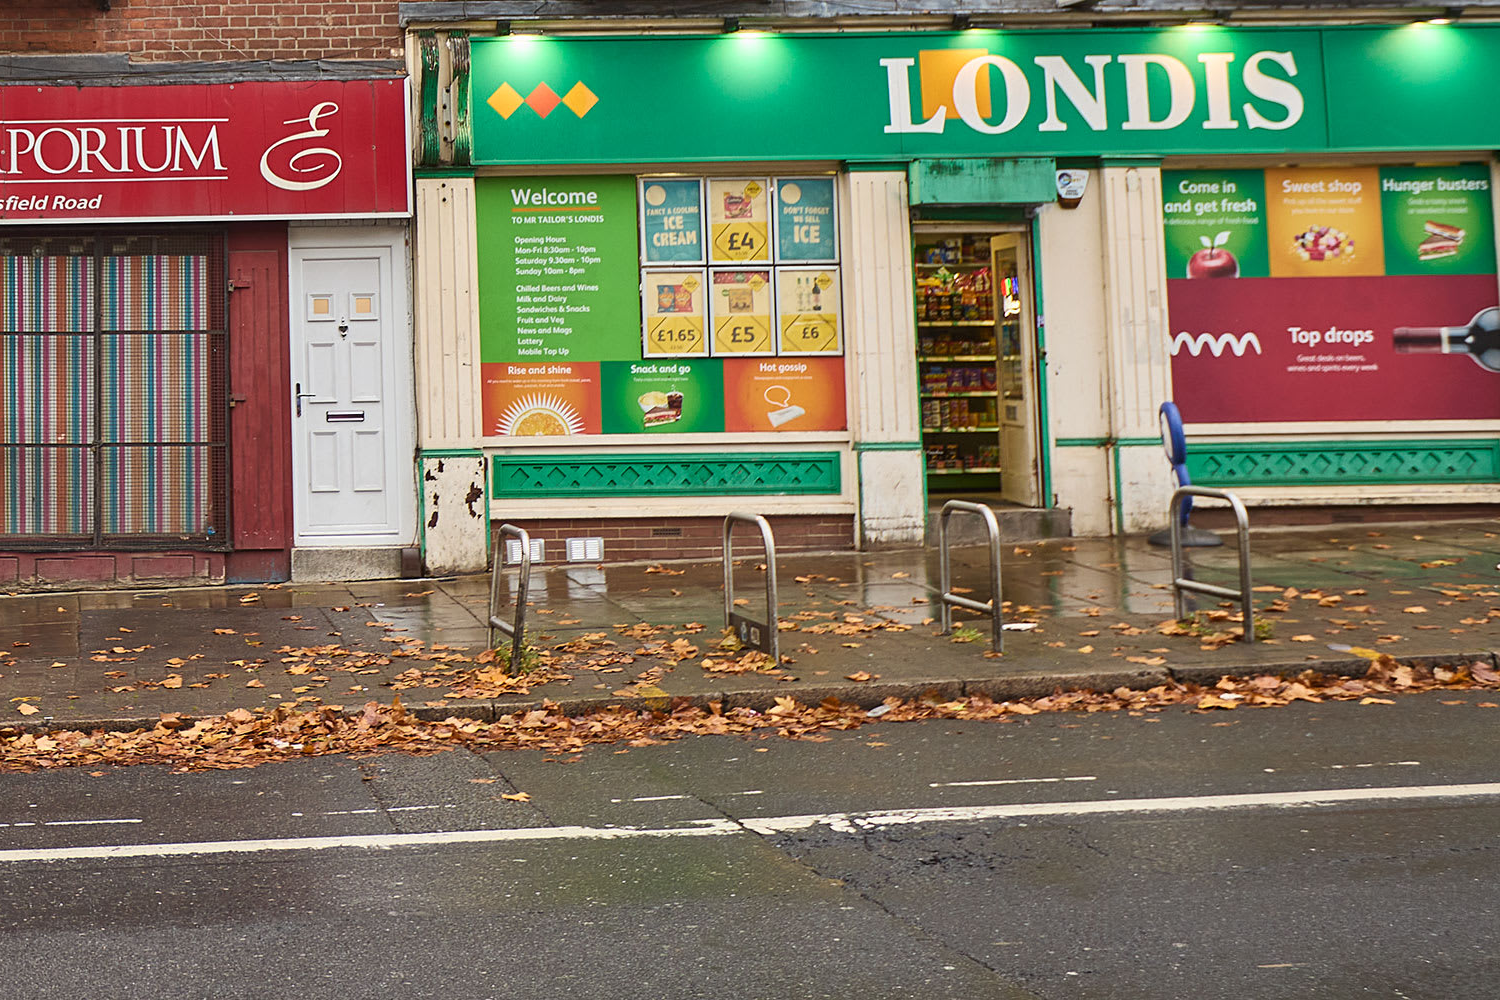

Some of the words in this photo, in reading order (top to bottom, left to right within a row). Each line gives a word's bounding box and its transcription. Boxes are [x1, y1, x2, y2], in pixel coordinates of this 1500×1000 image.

[880, 51, 1304, 135] LONDIS
[1179, 180, 1220, 194] Come
[1222, 180, 1236, 193] in
[1282, 179, 1325, 193] Sweet
[1328, 179, 1362, 196] shop
[1382, 178, 1434, 195] Hunger
[1436, 177, 1488, 191] busters
[52, 194, 102, 210] Road
[511, 188, 598, 205] Welcome
[647, 208, 666, 216] FANCY
[667, 207, 672, 215] A
[673, 206, 699, 215] COOLING
[783, 206, 803, 215] DON'T
[805, 206, 830, 215] FORGET
[1164, 199, 1191, 213] and
[1194, 200, 1218, 216] get
[1221, 198, 1257, 212] fresh
[511, 216, 523, 224] TO
[524, 216, 537, 224] MR
[538, 215, 573, 224] TAILOR'S
[574, 215, 604, 223] LONDIS
[663, 215, 684, 231] ICE
[805, 215, 821, 223] SELL
[653, 230, 697, 247] CREAM
[793, 225, 820, 243] ICE
[514, 236, 544, 245] Opening
[728, 232, 754, 251] £4
[515, 246, 542, 254] Mon-Fri
[576, 246, 596, 254] 10pm
[515, 257, 547, 266] Saturday
[581, 256, 601, 264] 10pm
[515, 267, 542, 276] Sunday
[569, 267, 586, 275] 8pm
[516, 285, 540, 293] Chilled
[562, 284, 576, 292] and
[533, 295, 547, 303] and
[548, 295, 567, 304] Dairy
[516, 306, 558, 314] Sandwiches
[566, 305, 590, 313] Snacks
[535, 316, 549, 324] and
[550, 316, 565, 325] Veg
[517, 327, 537, 335] News
[553, 327, 573, 335] Mags
[657, 329, 696, 342] £1.65
[731, 326, 755, 343] £5
[802, 326, 819, 340] £6
[1287, 326, 1321, 348] Top
[1324, 326, 1375, 347] drops
[517, 338, 544, 346] Lottery
[518, 348, 542, 356] Mobile
[543, 348, 557, 356] Top
[558, 348, 570, 356] Up
[508, 366, 526, 375] Rise
[528, 366, 546, 374] and
[547, 365, 572, 374] shine
[630, 364, 658, 374] Snack
[658, 363, 677, 373] and
[678, 365, 691, 375] go
[760, 362, 777, 372] Hot
[778, 362, 807, 374] gossip
